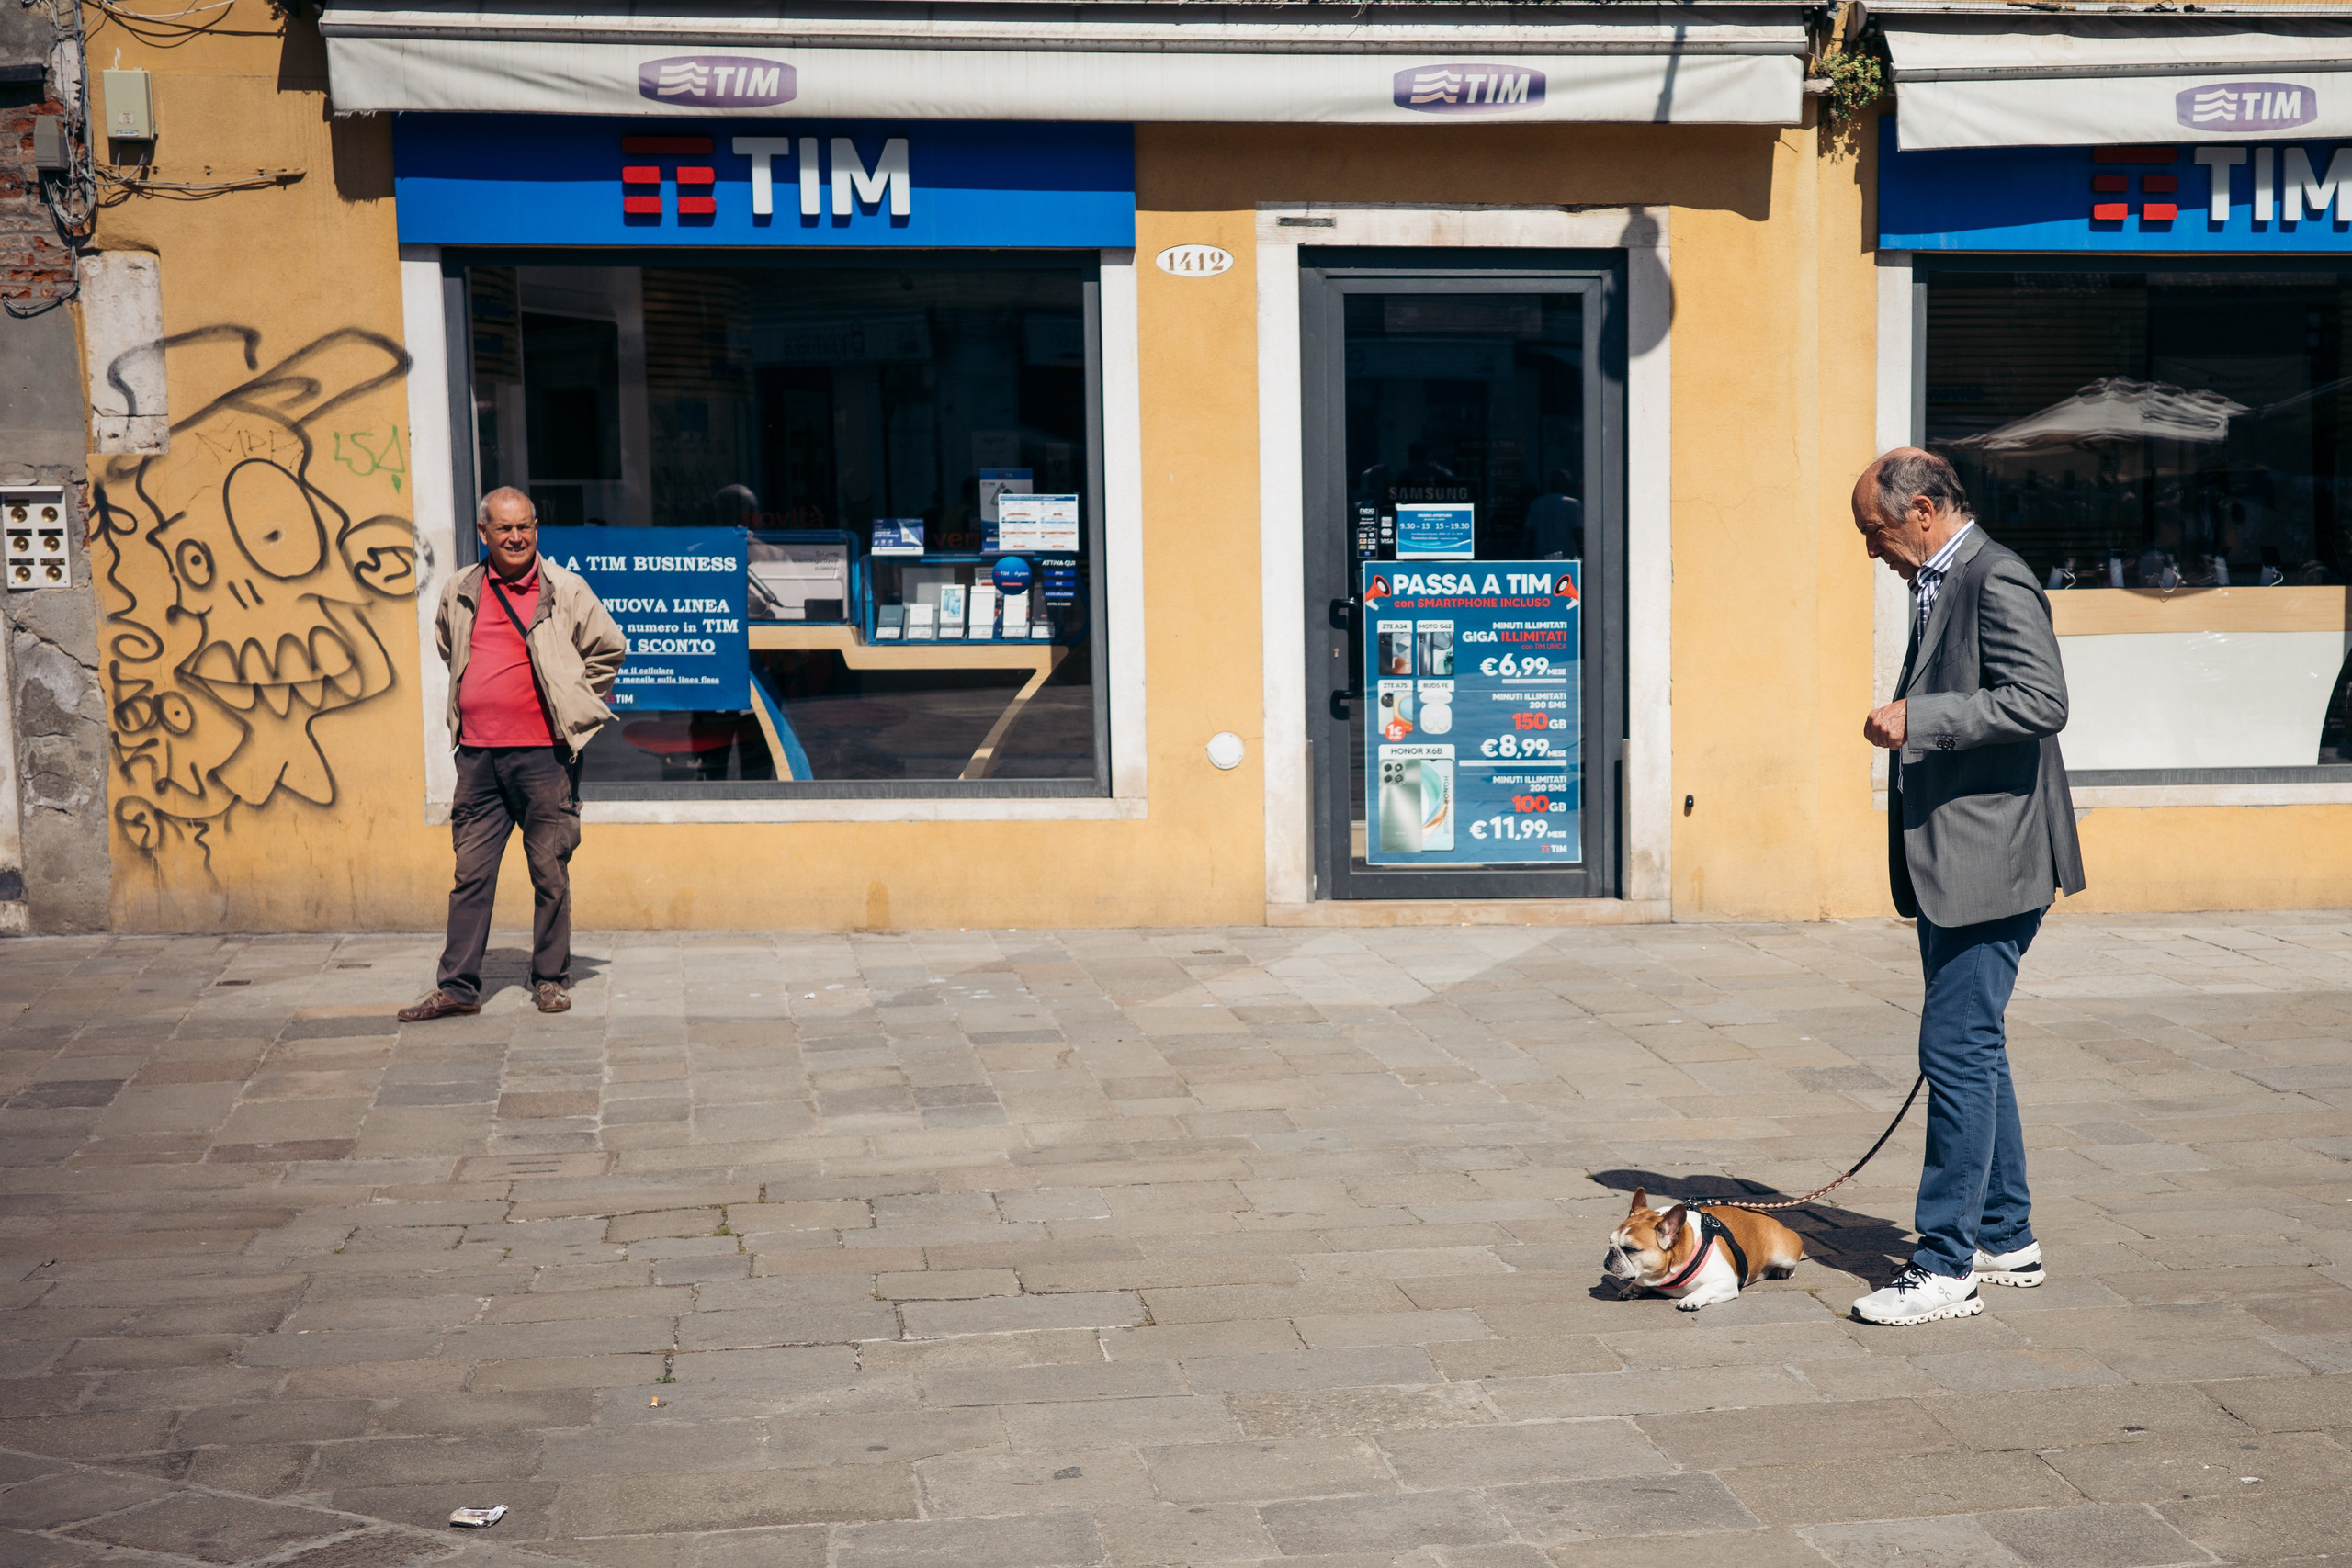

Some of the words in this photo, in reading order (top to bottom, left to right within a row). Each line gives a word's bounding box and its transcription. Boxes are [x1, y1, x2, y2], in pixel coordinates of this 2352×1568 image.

[712, 66, 780, 97] TIM
[1464, 73, 1531, 104] TIM
[2242, 90, 2301, 120] TIM
[731, 136, 911, 216] TIM
[2194, 146, 2352, 222] TIM
[1166, 250, 1225, 272] 1412
[1388, 486, 1469, 501] SAMSUNG
[564, 556, 581, 571] A
[586, 556, 627, 571] TIM
[633, 556, 738, 572] BUSINESS
[1064, 559, 1076, 568] QUI
[1393, 573, 1476, 595] PASSA
[1481, 574, 1501, 595] A
[1506, 574, 1551, 595] TIM
[602, 598, 668, 614] NUOVA
[673, 598, 730, 614] LINEA
[1394, 600, 1415, 608] con
[1417, 598, 1498, 608] SMARTPHONE
[1499, 598, 1551, 608] INCLUSO
[628, 624, 680, 633] numero
[683, 621, 697, 633] in
[702, 619, 739, 634] TIM
[1492, 621, 1522, 630] MINUTI
[1524, 621, 1567, 630] ILLIMITATI
[1462, 631, 1498, 643] GIGA
[1500, 631, 1567, 642] ILLIMITATI
[638, 638, 716, 653] SCONTO
[639, 667, 674, 675] cellulare
[1479, 652, 1549, 678] €6,99
[623, 676, 655, 684] mensile
[656, 676, 676, 684] sulla
[678, 676, 699, 684] linea
[615, 694, 633, 704] TIM
[1492, 693, 1523, 701] MINUTI
[1525, 693, 1567, 701] ILLIMITATI
[1529, 701, 1547, 709] 200
[1548, 701, 1567, 709] SMS
[1511, 712, 1549, 730] 150
[1548, 719, 1567, 730] GB
[1391, 747, 1424, 755] HONOR
[1425, 747, 1442, 755] X6B
[1479, 734, 1550, 760] €8,99
[1547, 750, 1567, 758] MESE
[1492, 775, 1523, 784] MINUTI
[1524, 775, 1567, 784] ILLIMITATI
[1530, 784, 1547, 793] 200
[1548, 784, 1567, 793] SMS
[1511, 795, 1549, 813] 100
[1548, 802, 1567, 813] GB
[1547, 830, 1567, 839] MESE
[1550, 845, 1567, 853] TIM
